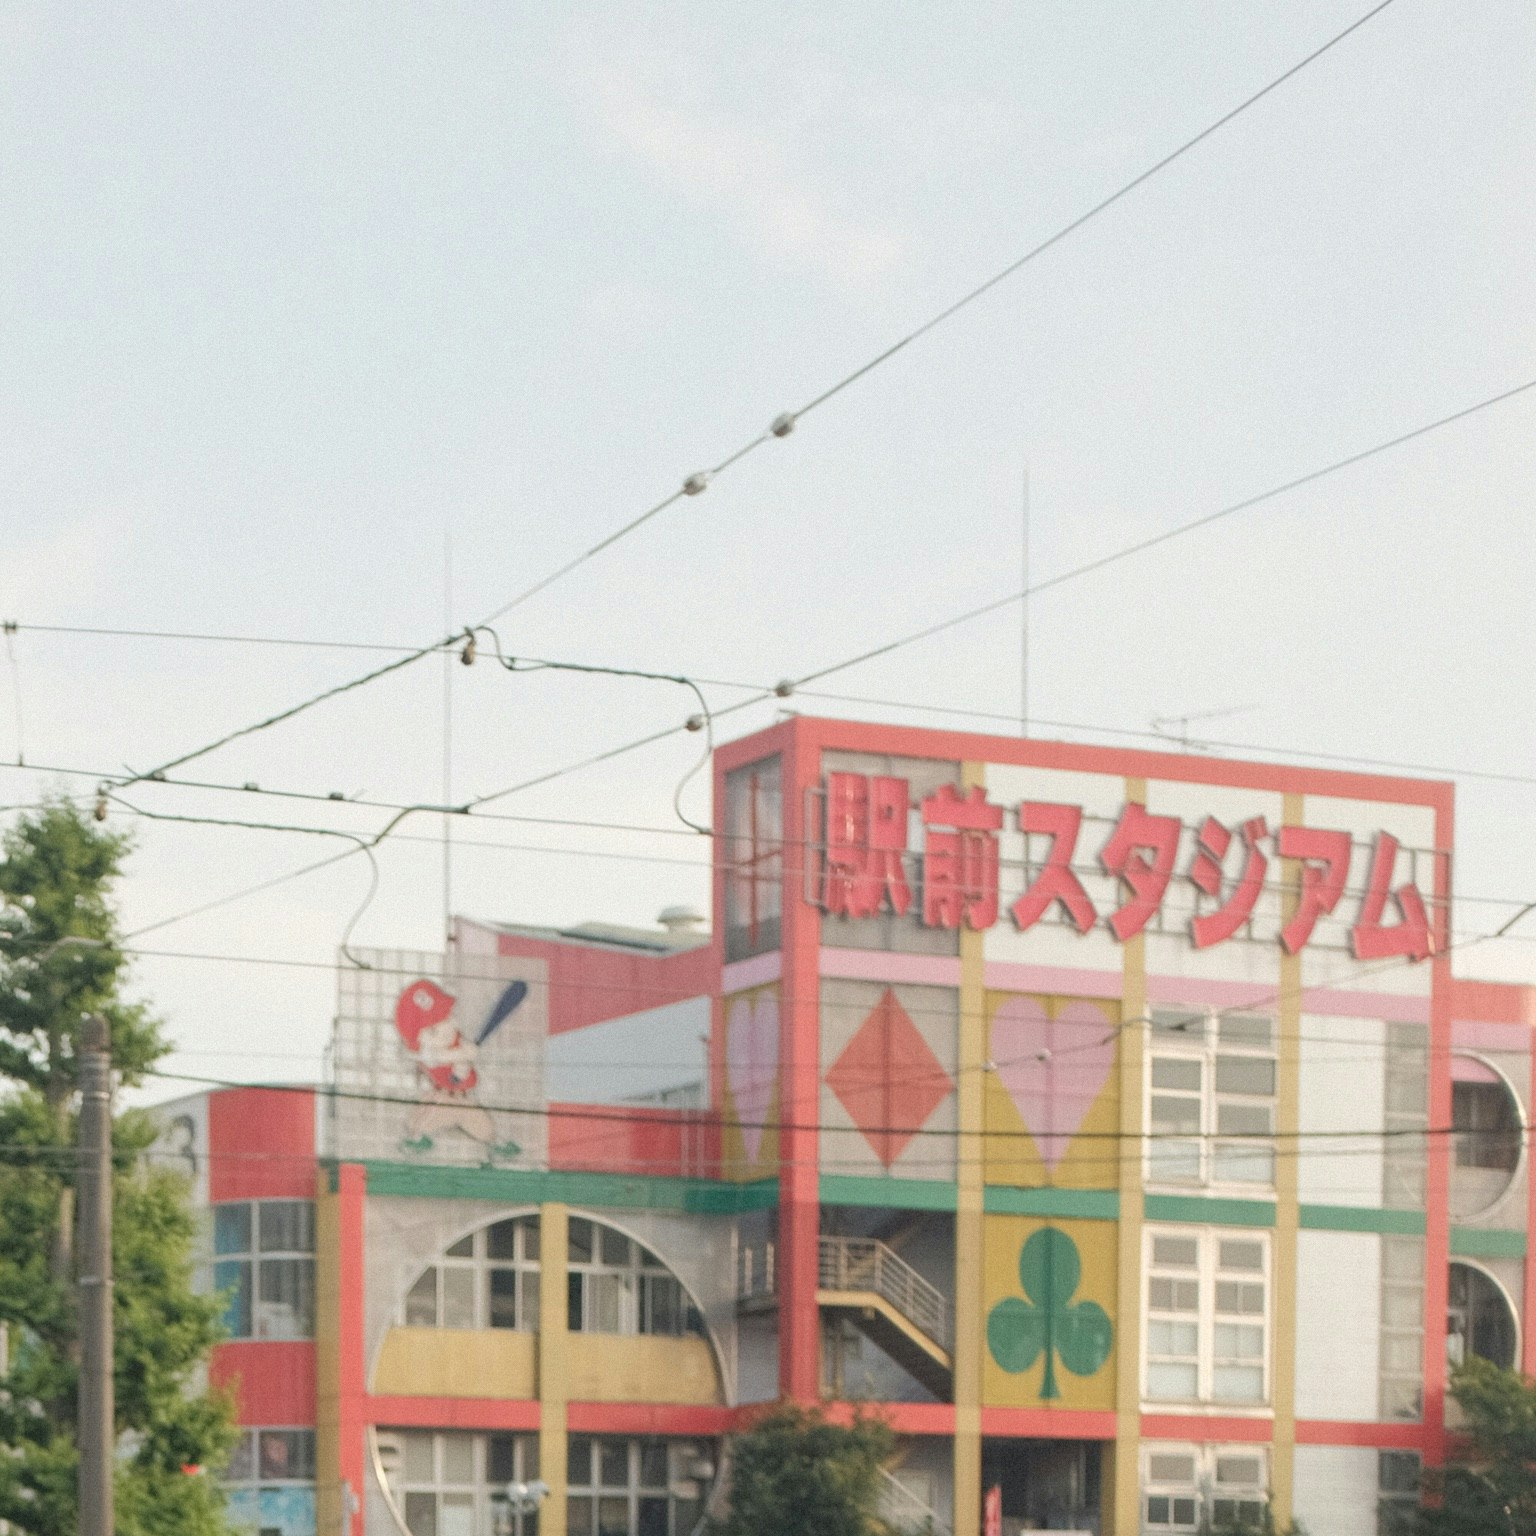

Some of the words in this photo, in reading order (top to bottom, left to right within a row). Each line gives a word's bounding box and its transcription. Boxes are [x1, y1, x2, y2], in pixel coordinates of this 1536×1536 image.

[826, 771, 1438, 962] 駅前スタジアム
